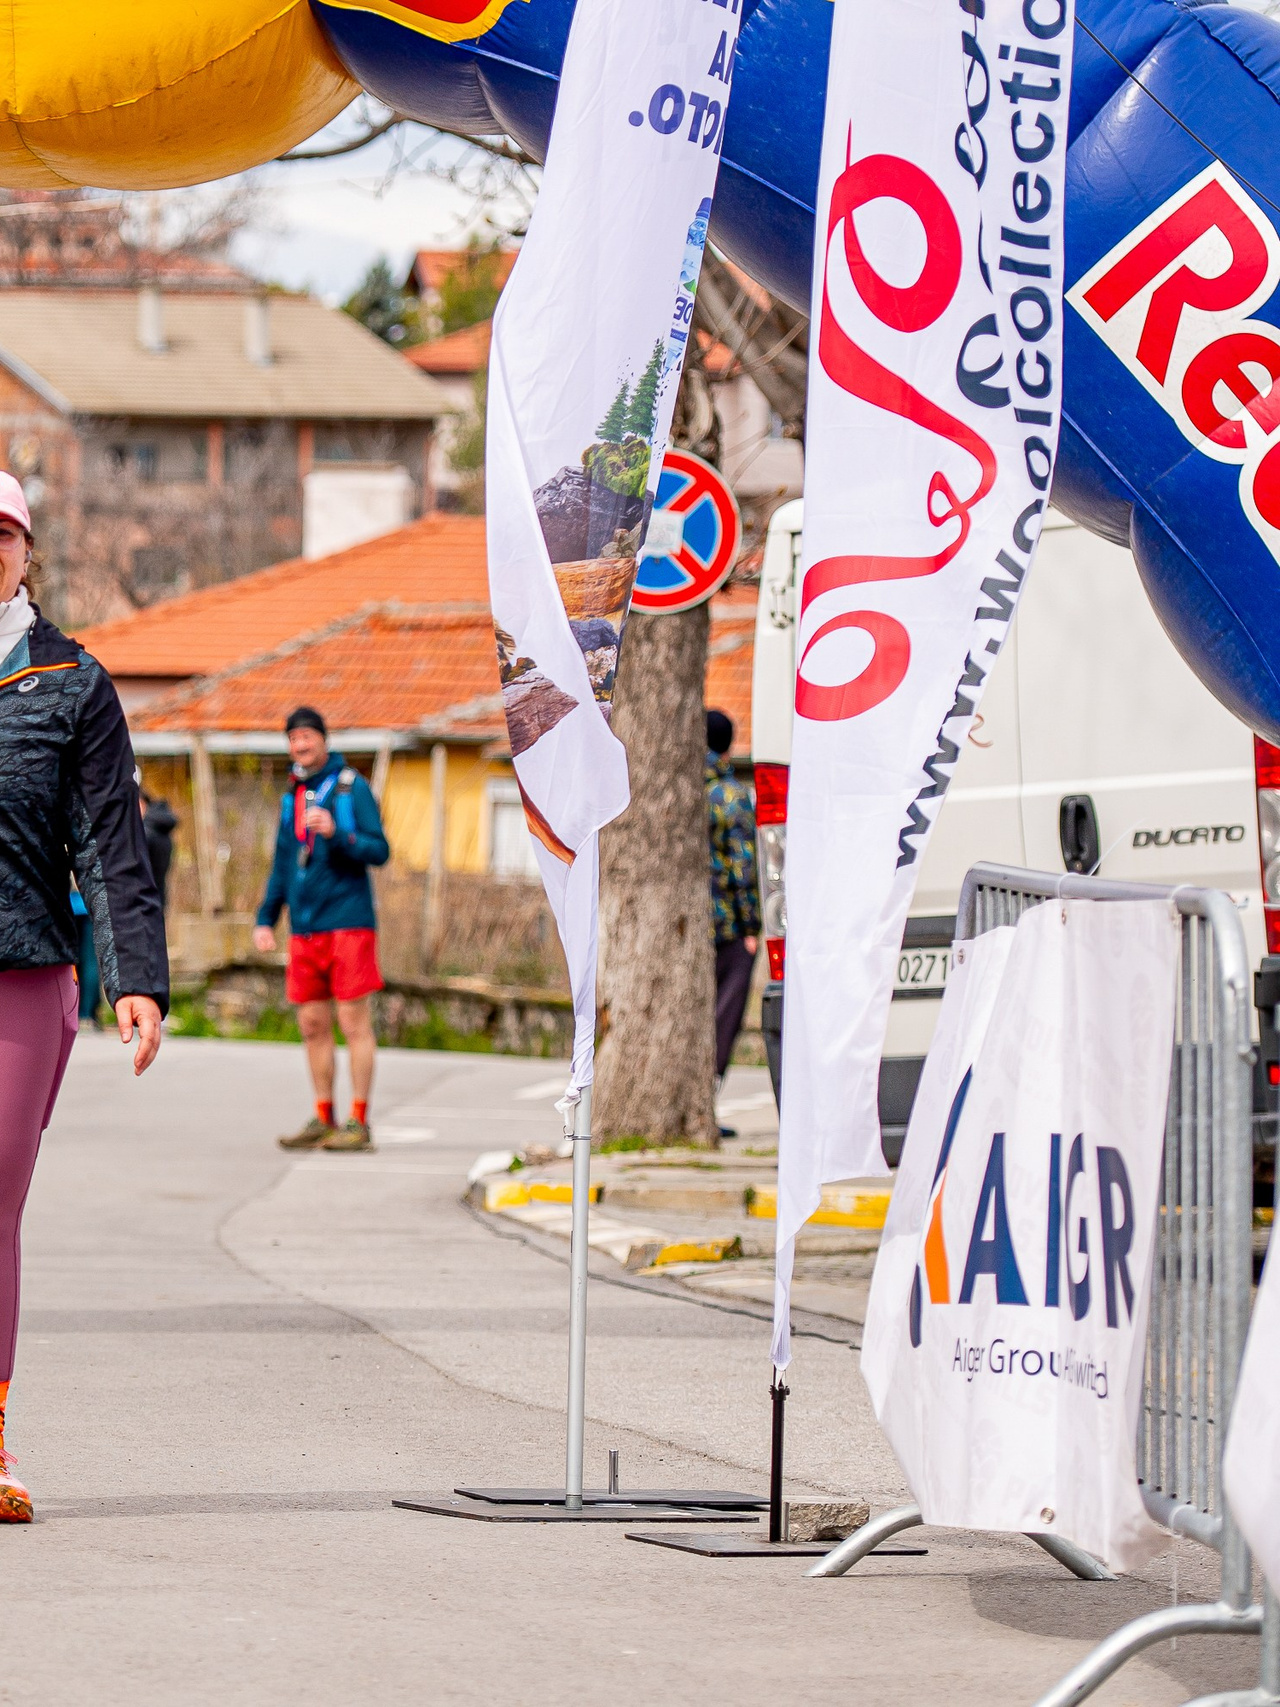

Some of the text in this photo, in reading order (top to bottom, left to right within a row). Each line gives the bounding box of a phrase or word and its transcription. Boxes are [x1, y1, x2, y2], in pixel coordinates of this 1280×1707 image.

[1133, 825, 1245, 848] DUCATO
[898, 954, 948, 984] 0271
[952, 1337, 985, 1382] Aiger
